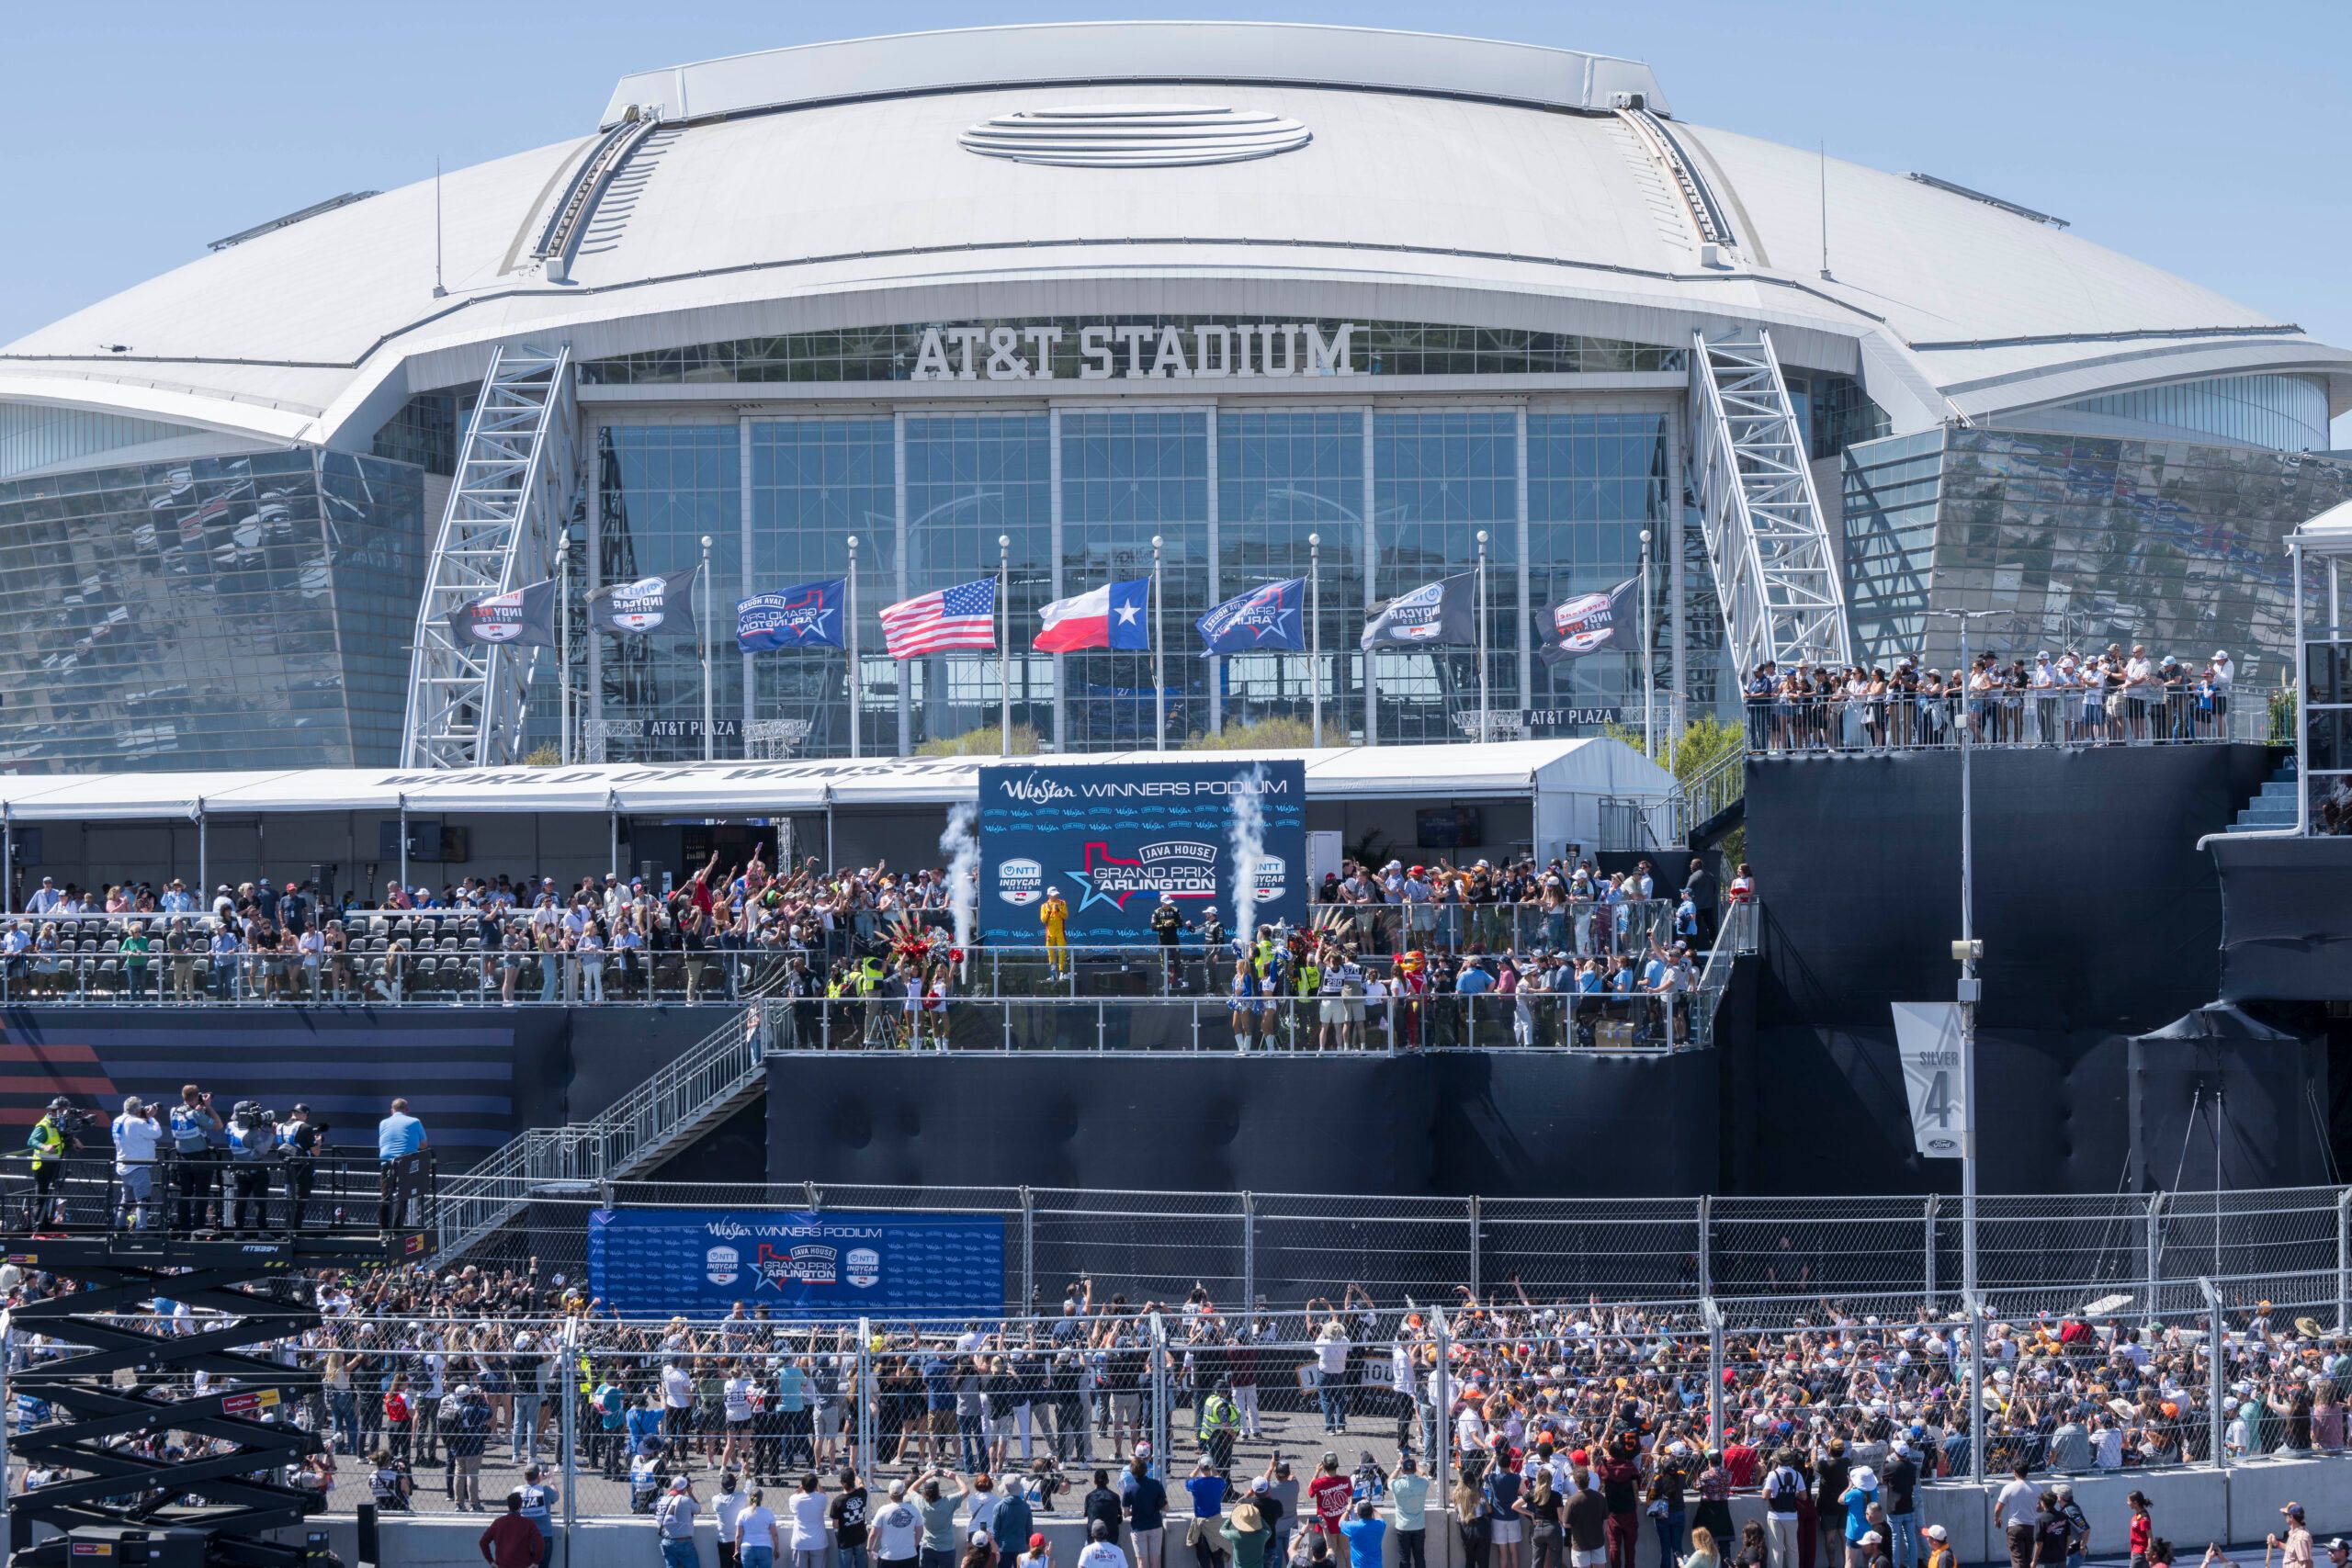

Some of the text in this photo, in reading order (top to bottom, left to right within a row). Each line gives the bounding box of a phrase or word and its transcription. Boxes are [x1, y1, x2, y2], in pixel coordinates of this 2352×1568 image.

[910, 323, 1354, 380] AT&T STADIUM
[1530, 708, 1613, 726] AT&T PLAZA
[651, 721, 686, 736] AT&T
[371, 764, 982, 786] WORLD OF WINSTA
[1000, 769, 1287, 805] WinStar WINNERS PODIUM
[1147, 844, 1211, 859] JAVA HOUSE
[1093, 866, 1216, 879] GRAND PRIX
[1252, 874, 1285, 883] DYCAR
[1000, 878, 1041, 886] INDYCAR
[1100, 878, 1216, 891] ARLINGTON
[1919, 1051, 1958, 1066] SILVER
[1925, 1070, 1951, 1128] 4
[1933, 1140, 1952, 1149] Ford
[705, 1215, 882, 1240] WinStar WINNERS PODIUM
[794, 1248, 833, 1257] JAVA HOUSE
[763, 1261, 836, 1270] GRAND PRIX
[766, 1269, 836, 1279] ARLINGTON
[1319, 1483, 1349, 1495] Traveller
[521, 1496, 538, 1507] 74
[1321, 1490, 1348, 1511] 40
